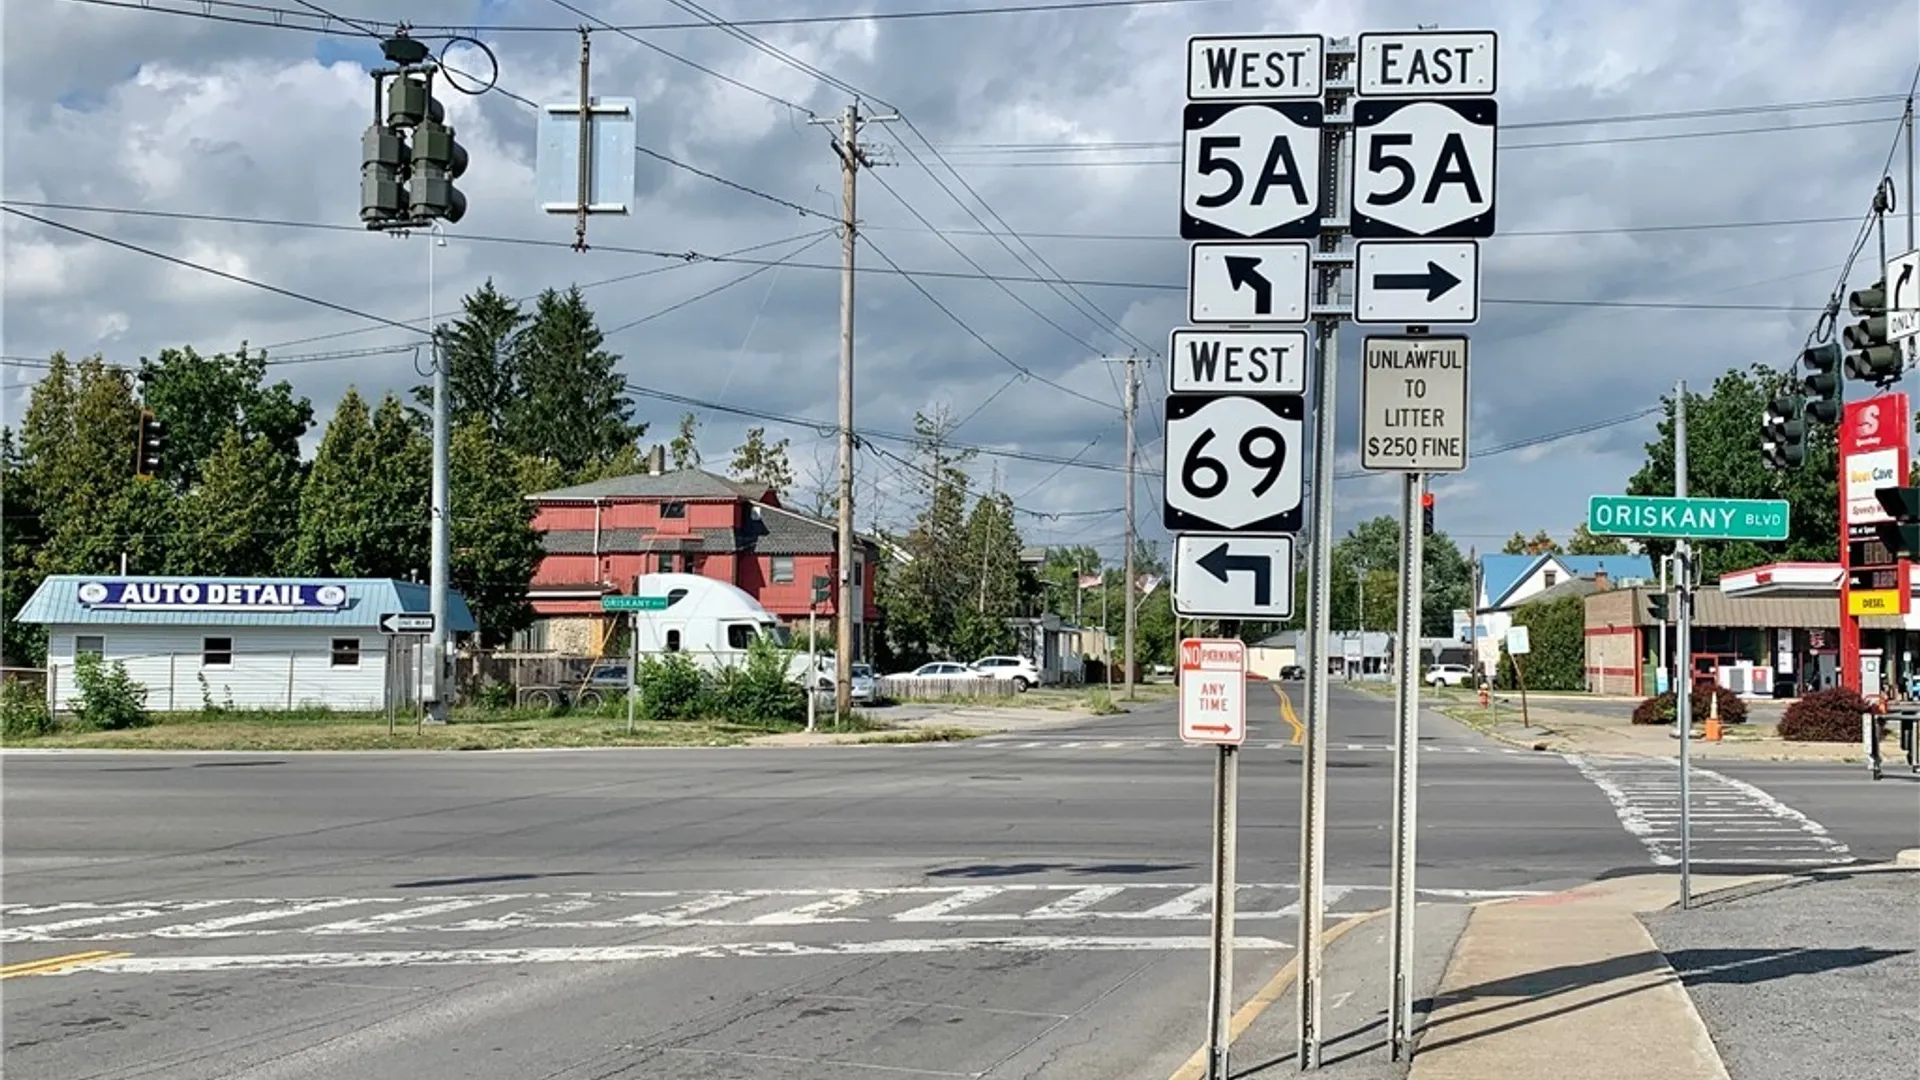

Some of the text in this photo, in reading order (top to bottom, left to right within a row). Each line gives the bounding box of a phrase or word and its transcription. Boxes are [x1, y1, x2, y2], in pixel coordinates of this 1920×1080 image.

[1206, 47, 1306, 89] WEST
[1380, 43, 1474, 85] EAST
[1196, 135, 1309, 208] 5A
[1366, 133, 1483, 206] 5A
[1892, 312, 1917, 334] ONLY
[1190, 341, 1290, 384] WEST
[1369, 349, 1462, 370] UNLAWFUL
[1405, 379, 1427, 398] TO
[1385, 409, 1445, 428] LITTER
[1368, 436, 1461, 458] $250 FINE
[1181, 426, 1287, 499] 69
[1873, 467, 1893, 481] Cave
[1596, 504, 1781, 529] ORISKANY BLVD
[120, 583, 200, 604] AUTO
[207, 584, 304, 605] DETAIL
[603, 597, 651, 607] ORISKANY
[1862, 598, 1885, 608] DIESEL
[1183, 646, 1241, 666] NO PARKING
[1201, 683, 1225, 697] ANY
[1199, 697, 1229, 712] TIME
